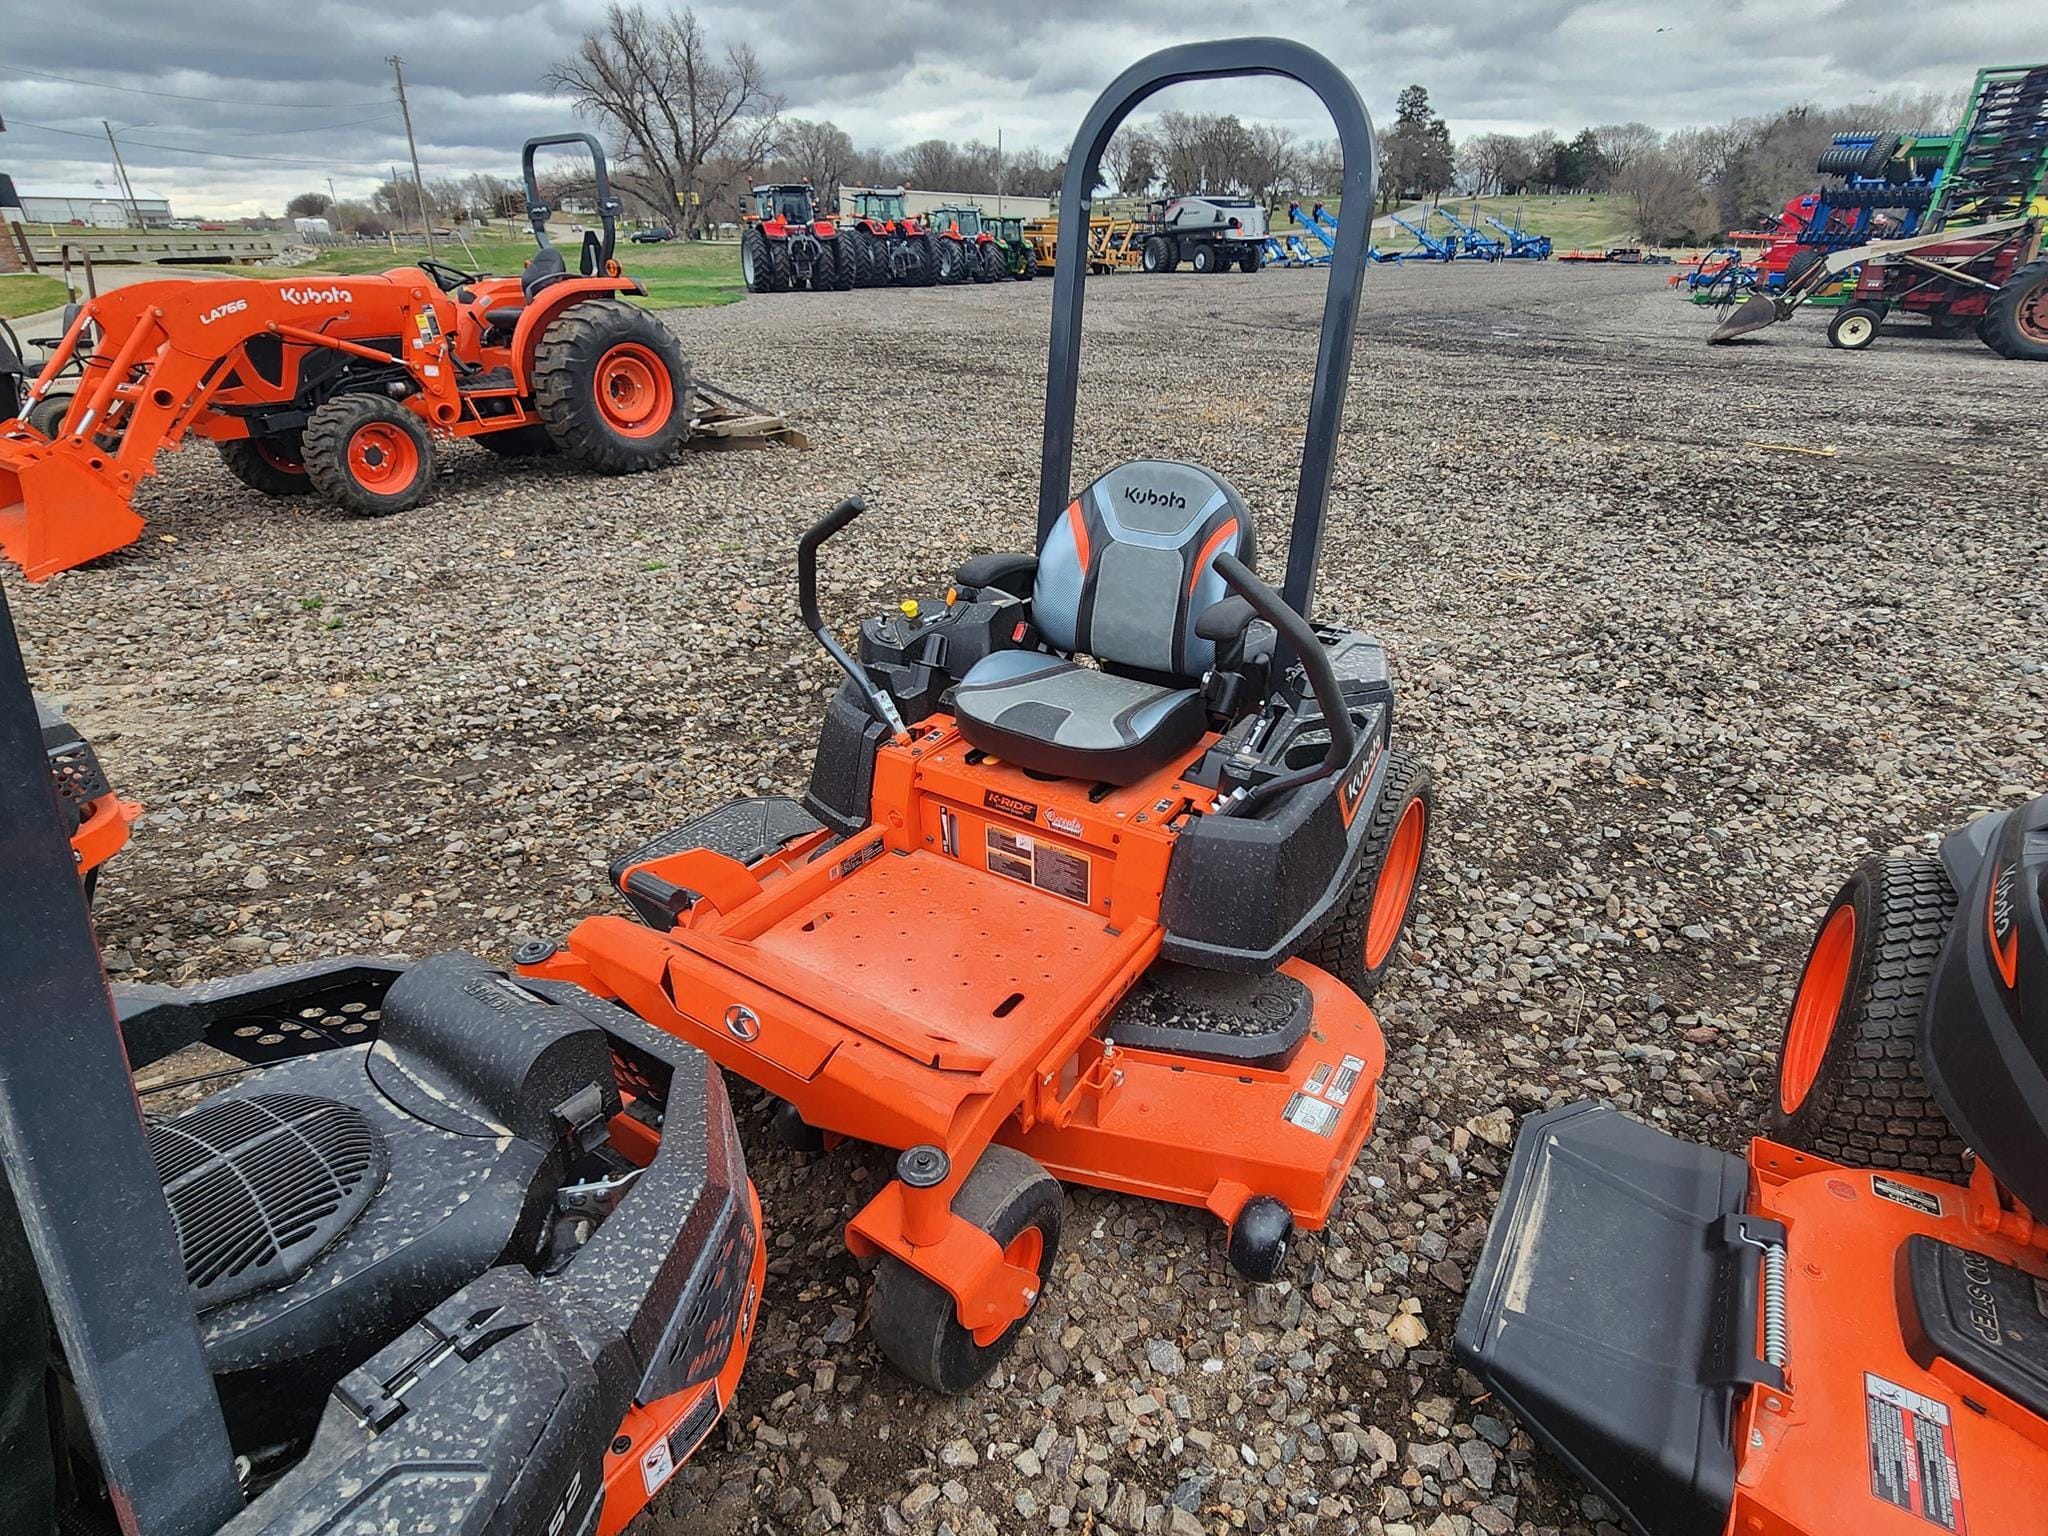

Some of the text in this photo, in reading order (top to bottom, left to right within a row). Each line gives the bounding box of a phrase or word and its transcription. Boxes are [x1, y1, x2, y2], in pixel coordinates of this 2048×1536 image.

[199, 299, 248, 325] LA766
[280, 287, 353, 305] Kubota
[1124, 486, 1186, 509] Kubota
[1348, 734, 1381, 799] Kubota
[988, 793, 1034, 814] K-RIDE
[1994, 862, 2018, 938] Kubota
[1966, 1284, 2002, 1345] STEP
[1906, 1446, 1917, 1482] PELIGRO
[1947, 1464, 1959, 1500] DANGER
